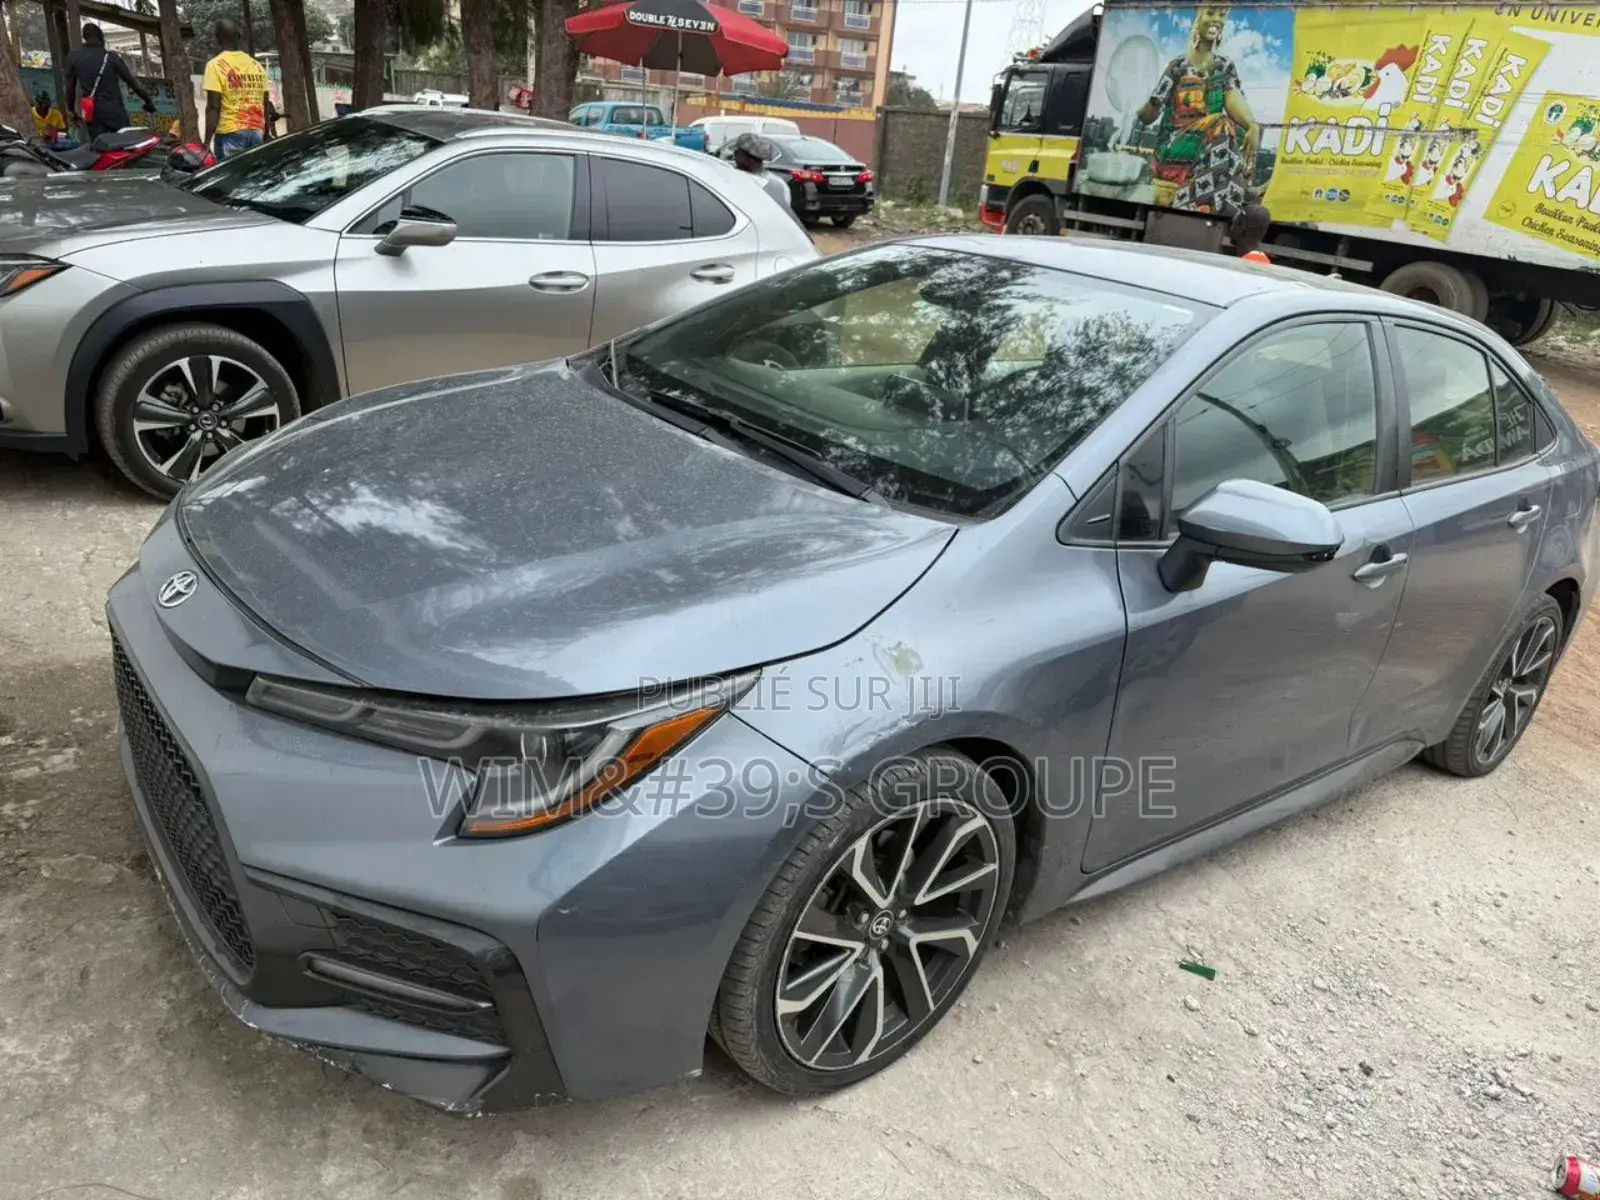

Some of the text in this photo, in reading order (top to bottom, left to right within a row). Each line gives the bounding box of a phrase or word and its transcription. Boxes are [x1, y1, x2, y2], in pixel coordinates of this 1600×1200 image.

[629, 10, 665, 25] DOUBLE
[1530, 7, 1600, 28] UNIVE
[1521, 215, 1555, 237] Chicken
